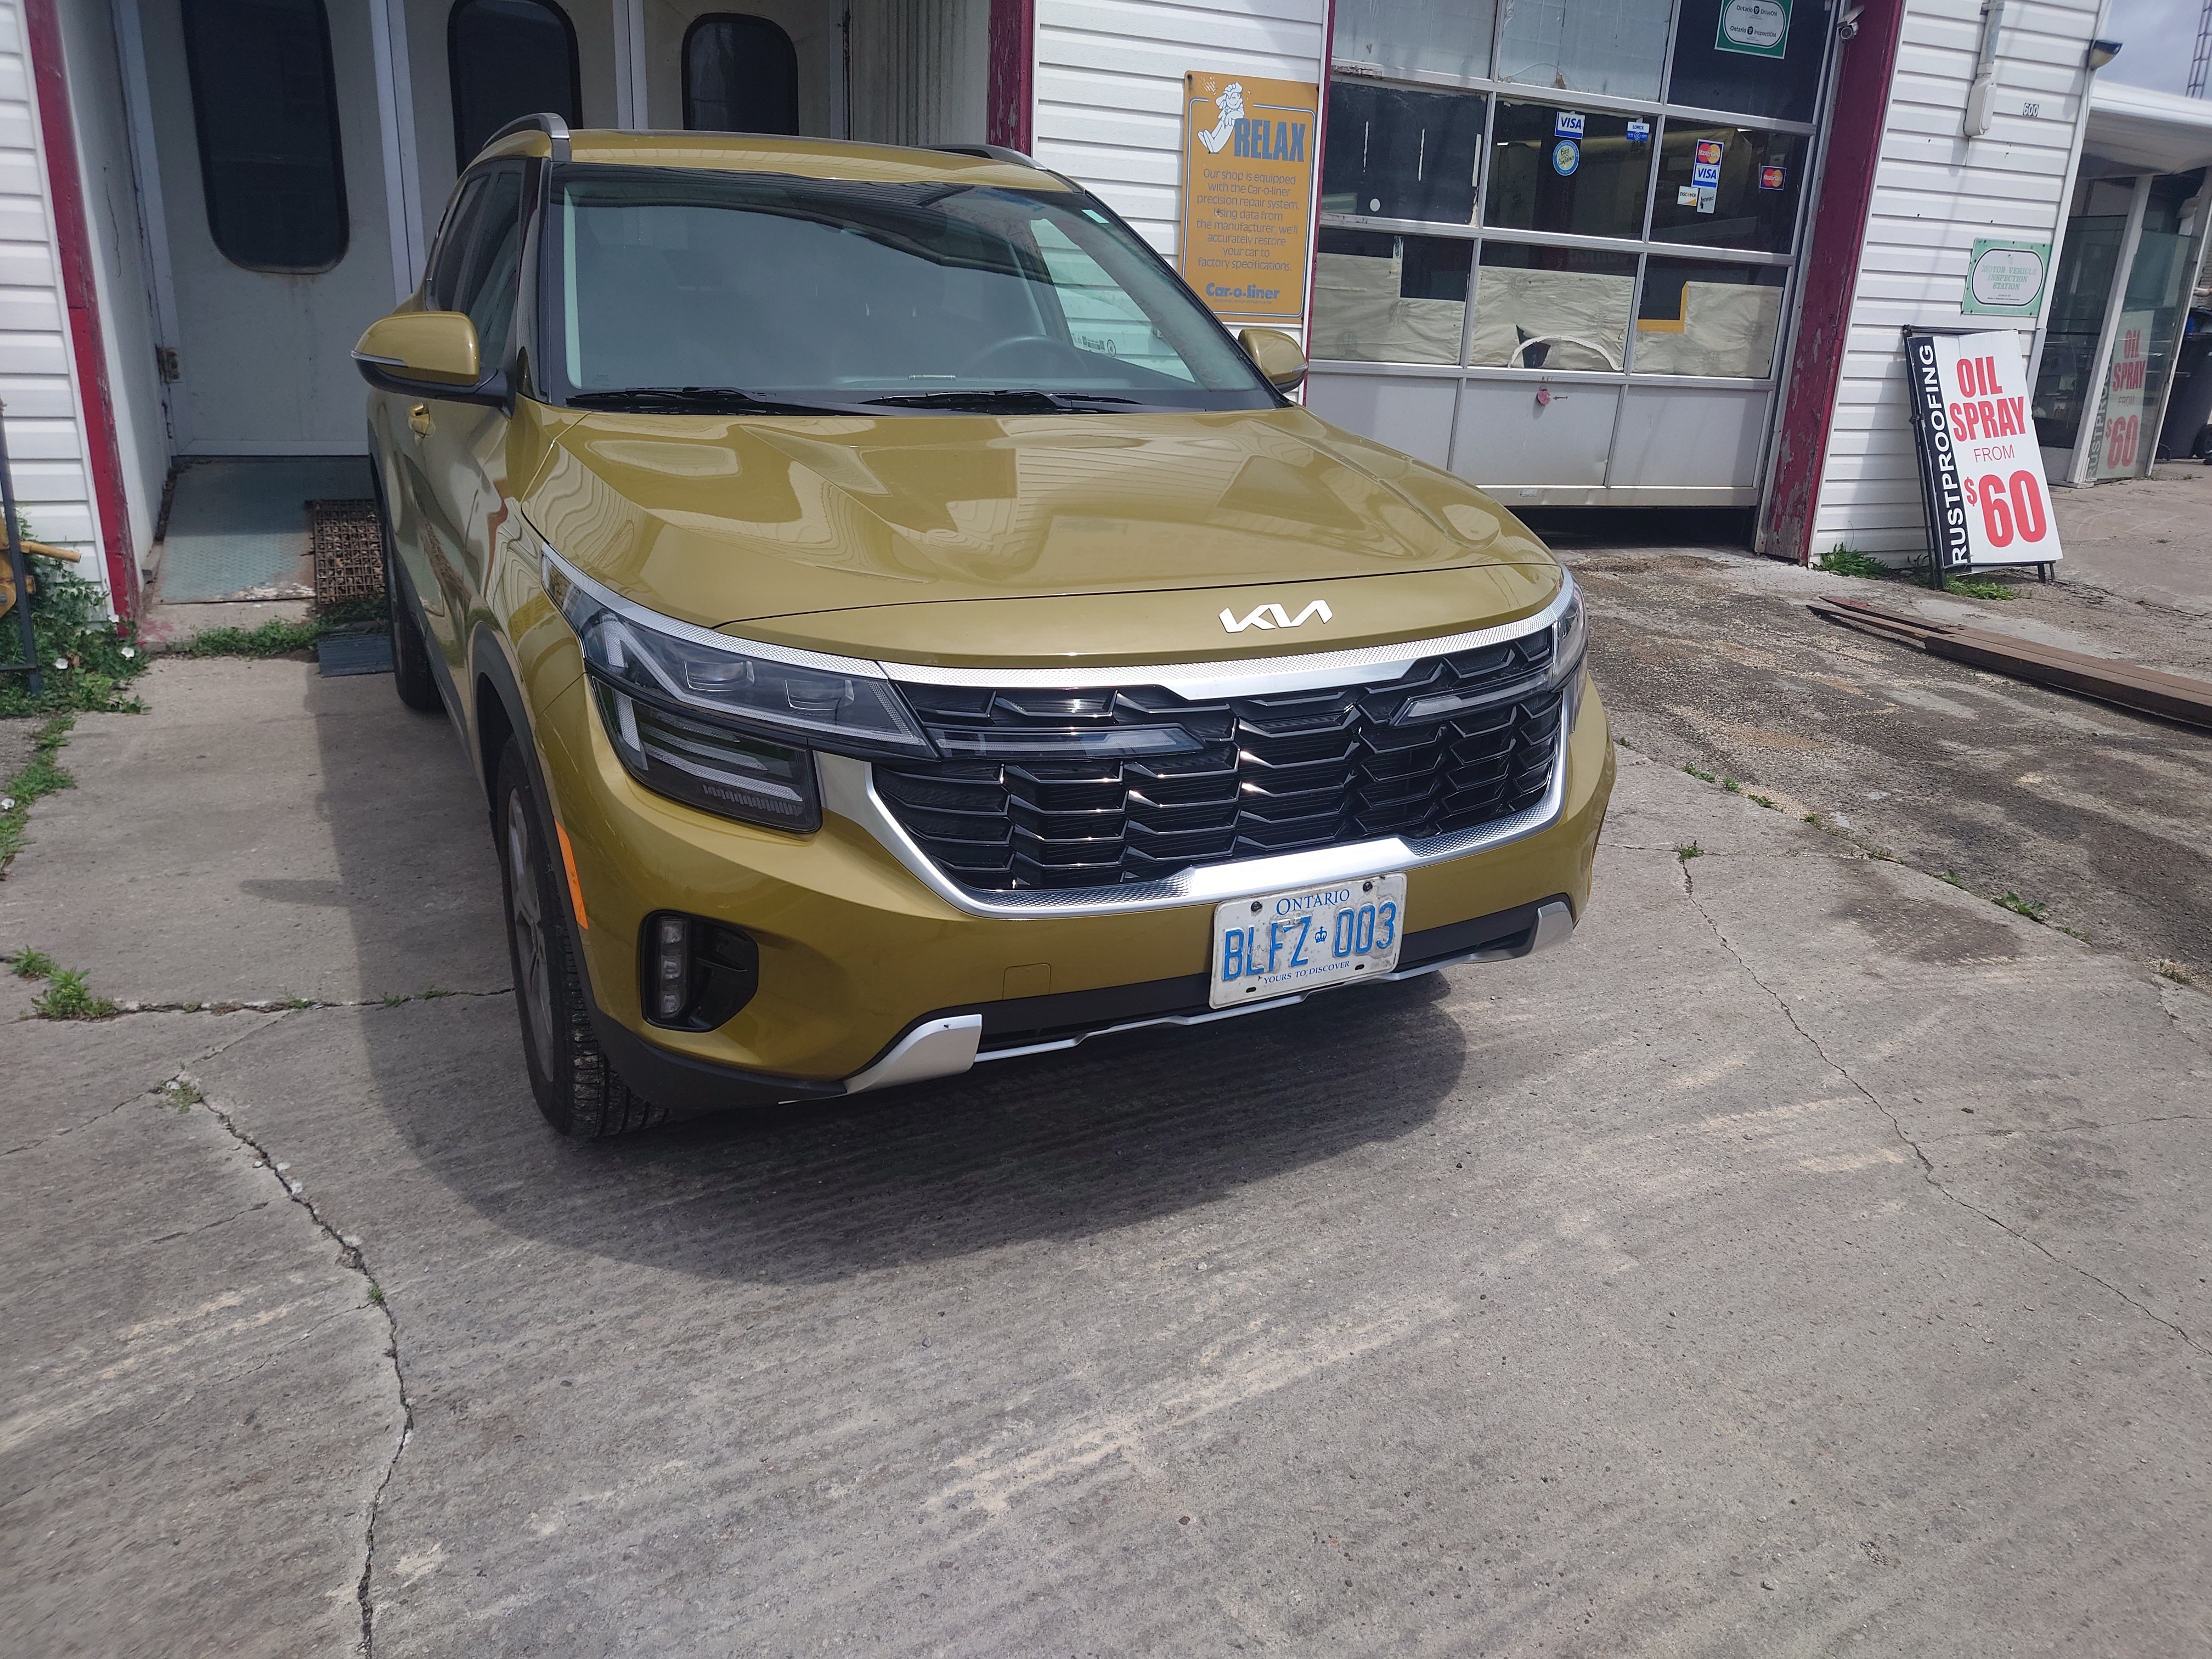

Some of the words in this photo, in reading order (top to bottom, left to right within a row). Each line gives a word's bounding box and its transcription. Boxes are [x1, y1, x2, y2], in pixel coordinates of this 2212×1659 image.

[1730, 25, 1747, 33] Ontario
[1754, 29, 1776, 38] InspectiON
[2023, 103, 2039, 117] 600
[1560, 117, 1582, 129] VISA
[1234, 117, 1306, 163] RELAX
[1698, 149, 1720, 158] MasterCard
[1203, 168, 1220, 179] Our
[1222, 170, 1244, 182] shop
[1246, 171, 1252, 182] is
[1254, 173, 1296, 185] equipped
[1697, 167, 1717, 179] VISA
[1208, 182, 1228, 192] with
[1231, 183, 1246, 194] the
[1248, 184, 1291, 197] Car-o-liner
[1197, 194, 1238, 205] precision
[1240, 198, 1266, 208] repair
[1267, 199, 1300, 211] system.
[1214, 207, 1238, 219] Using
[1240, 209, 1259, 220] data
[1261, 210, 1283, 221] from
[1197, 219, 1212, 229] the
[1279, 225, 1298, 235] we'll
[1207, 233, 1253, 246] accurately
[1255, 236, 1286, 246] restore
[1223, 247, 1244, 257] your
[1245, 248, 1259, 257] car
[1260, 249, 1270, 258] to
[1198, 257, 1230, 269] factory
[1232, 259, 1292, 272] specifications.
[1982, 265, 2006, 273] MOTOR
[2009, 267, 2038, 275] VEHICLE
[1988, 274, 2029, 283] INSPECTION
[1993, 282, 2021, 290] STATION
[1205, 282, 1280, 300] Car-o-liner
[2124, 330, 2141, 359] OIL
[1955, 356, 2003, 398] OIL
[2113, 360, 2146, 392] SPRAY
[2118, 396, 2135, 408] FROM
[1949, 396, 2027, 442] SPRAY
[2106, 414, 2138, 470] $60
[1919, 345, 1968, 565] RUSTPROOFING
[1973, 444, 2015, 463] FROM
[1963, 470, 2047, 548] $60
[1218, 599, 1333, 633] KIA
[1276, 889, 1350, 916] ONTARIO
[1222, 916, 1312, 981] BLFZ
[1334, 901, 1397, 957] 003
[1264, 973, 1292, 984] YOURS
[1295, 969, 1307, 977] TO
[1309, 961, 1350, 975] DISCOVER
